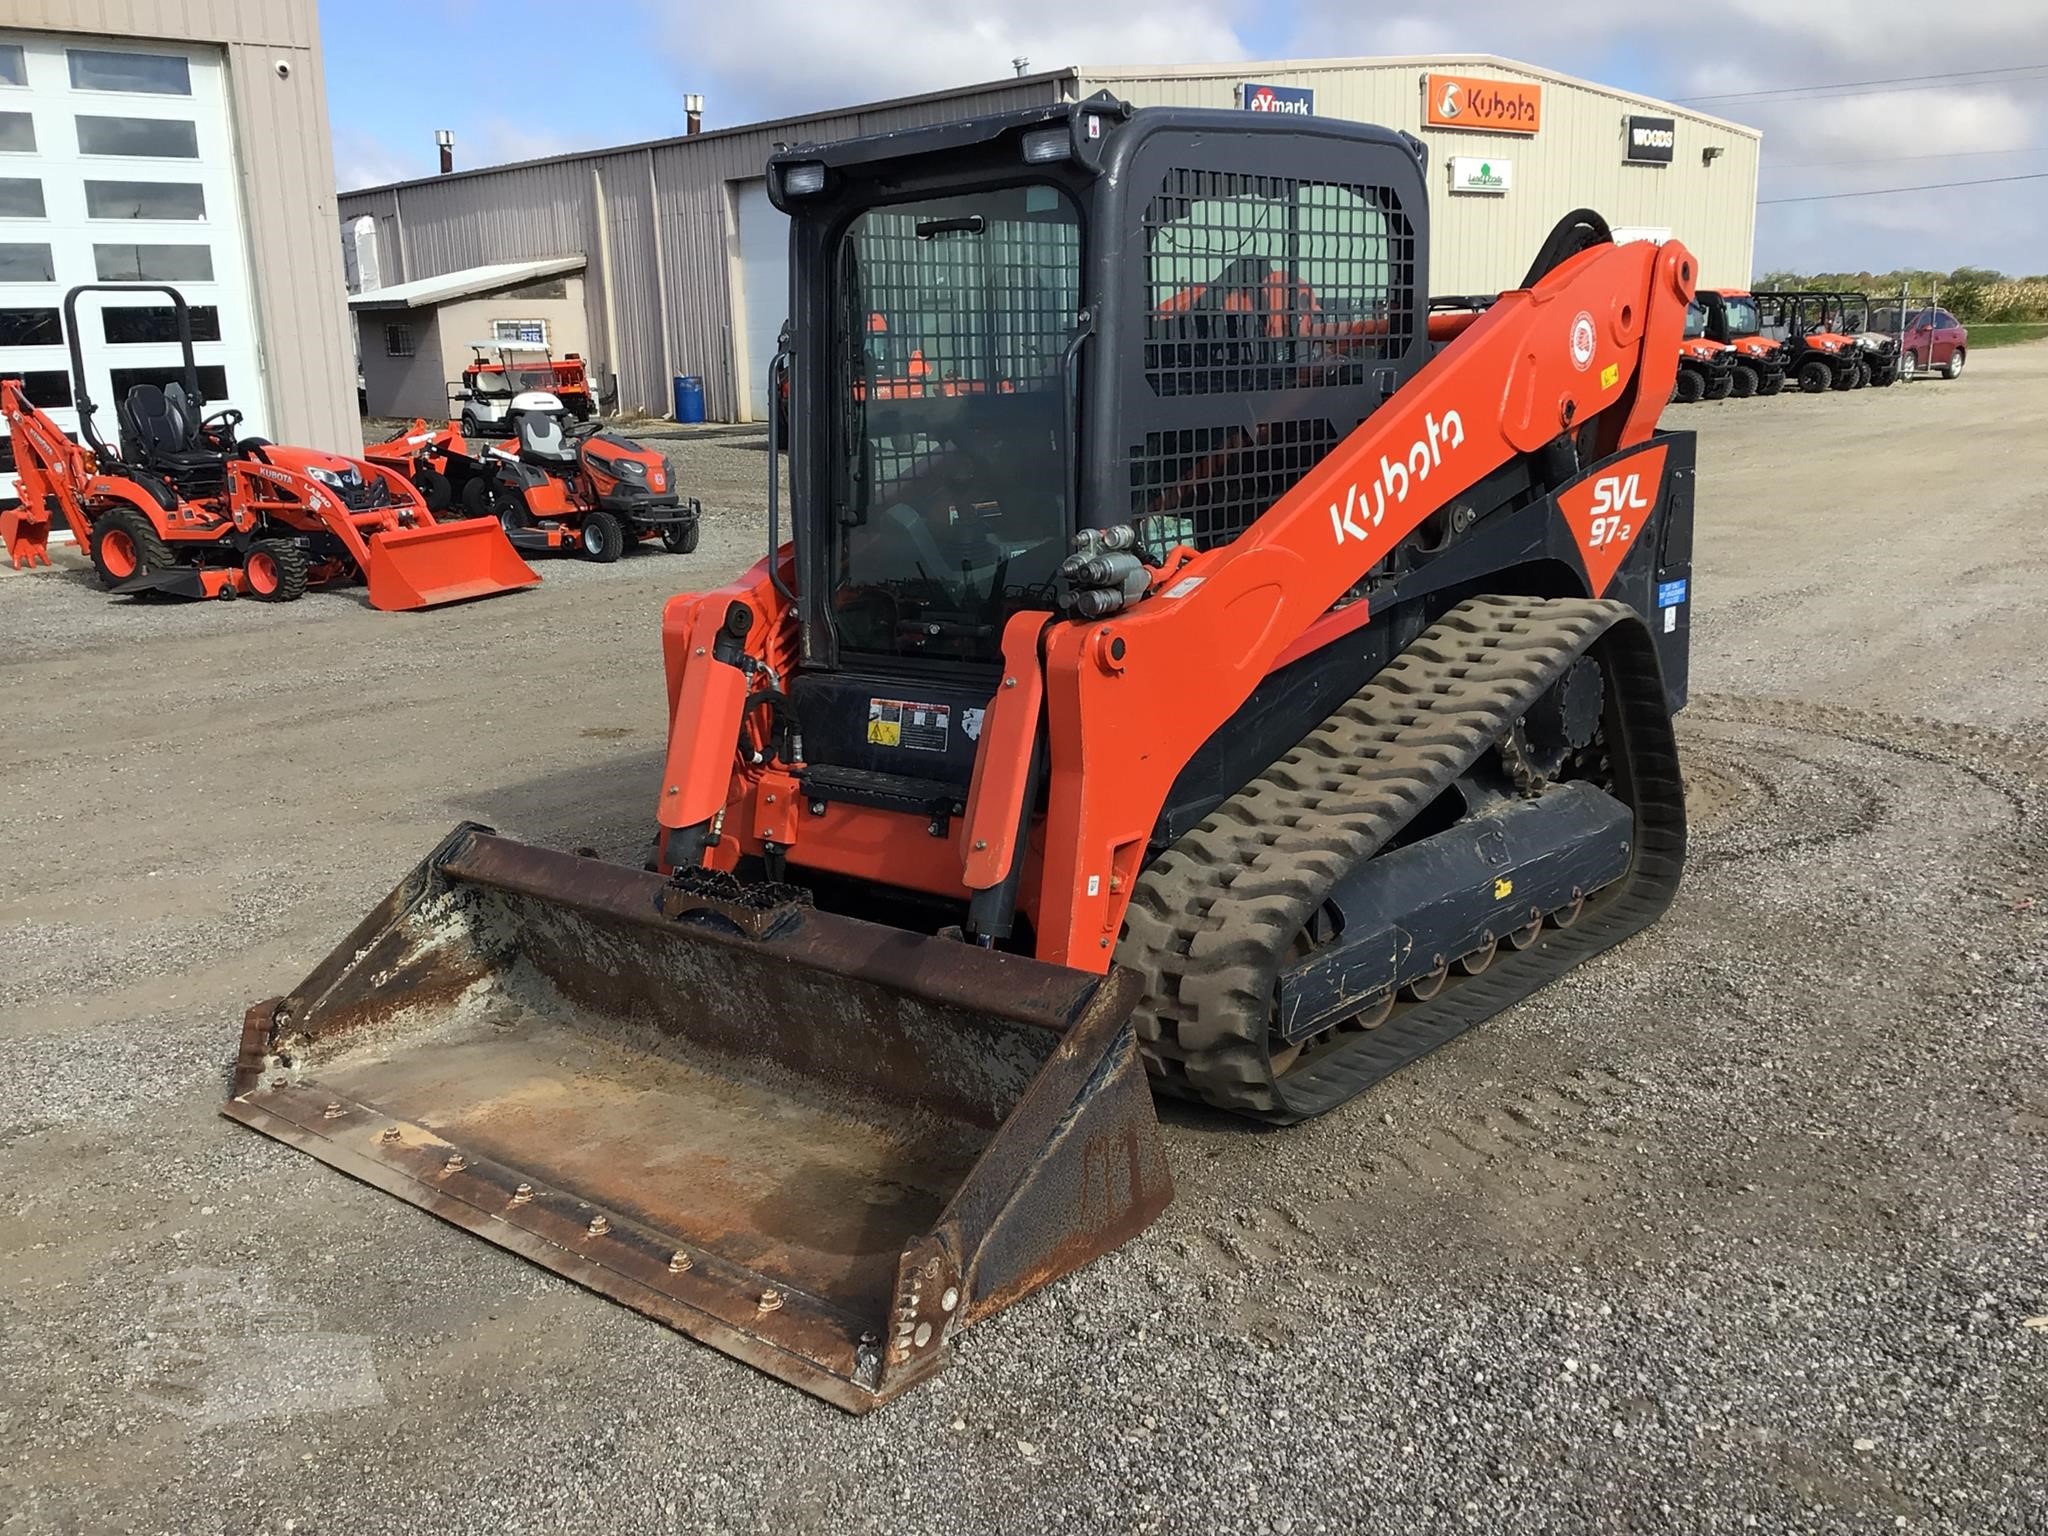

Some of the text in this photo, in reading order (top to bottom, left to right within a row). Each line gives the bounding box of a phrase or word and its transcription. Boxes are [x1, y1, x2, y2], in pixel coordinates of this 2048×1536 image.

[1468, 88, 1535, 121] Kubota
[1633, 128, 1673, 148] WOODS
[260, 466, 293, 484] KUBOTA
[1329, 410, 1465, 545] Kubota
[1590, 473, 1648, 516] SVL
[1589, 515, 1631, 547] 97-2
